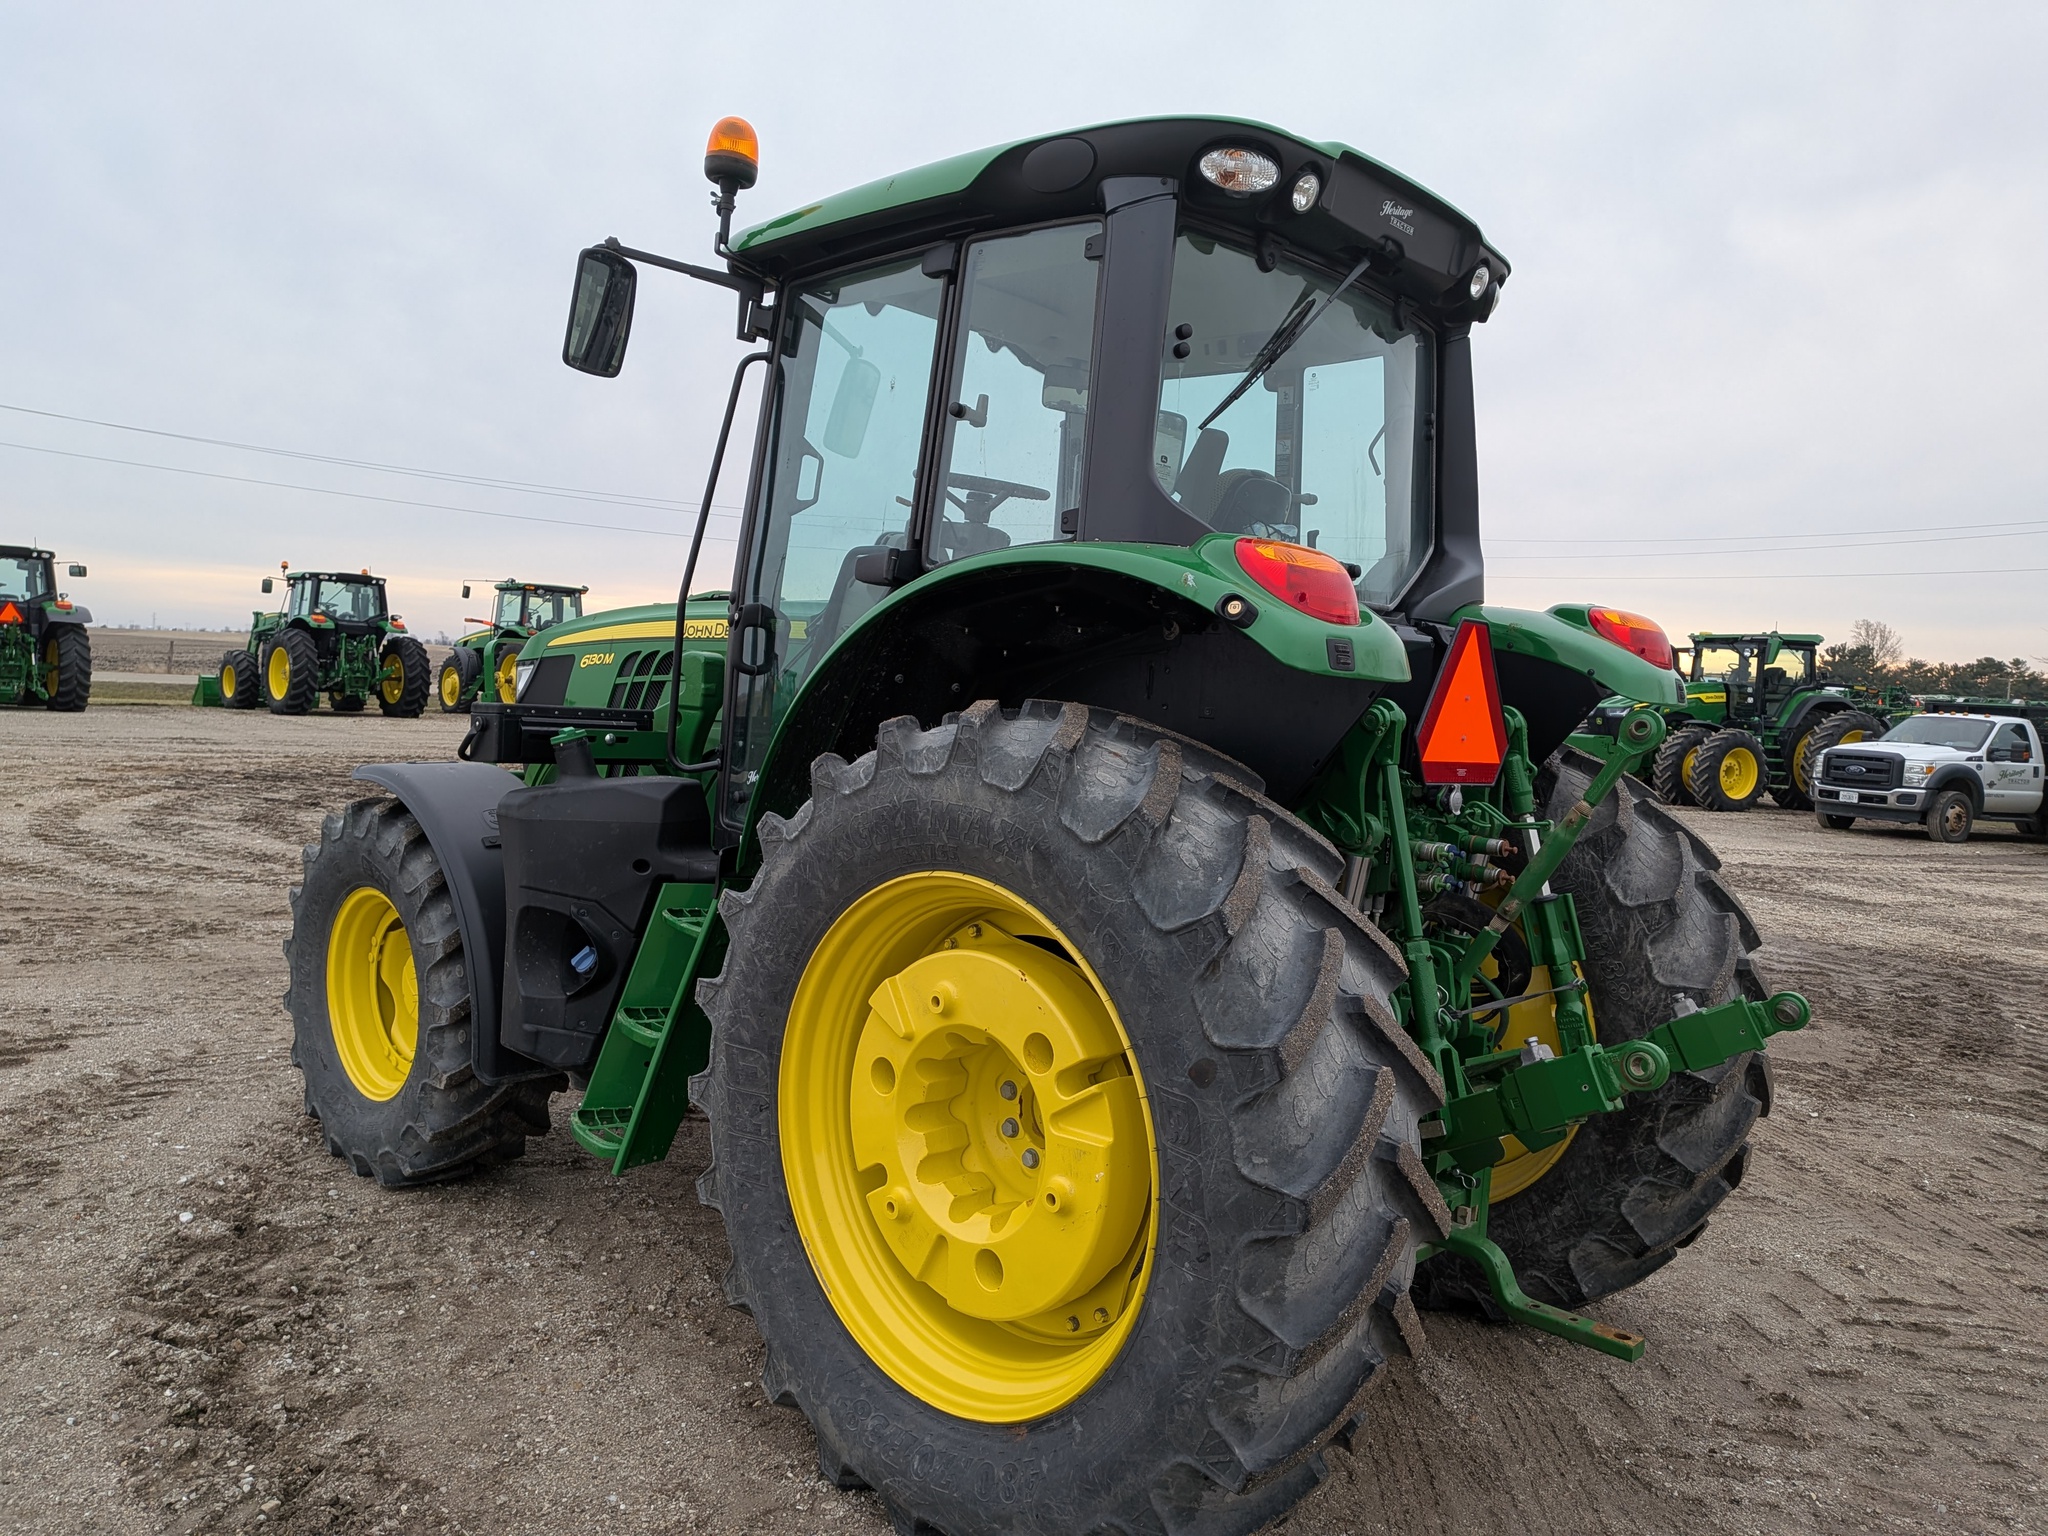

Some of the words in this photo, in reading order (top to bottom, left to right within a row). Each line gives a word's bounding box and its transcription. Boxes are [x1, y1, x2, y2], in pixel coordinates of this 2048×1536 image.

[1379, 200, 1414, 220] Heritage
[1389, 215, 1415, 236] TRACTOR
[683, 622, 713, 637] JOHN
[579, 651, 616, 668] 6130M
[1997, 768, 2026, 782] Heritage
